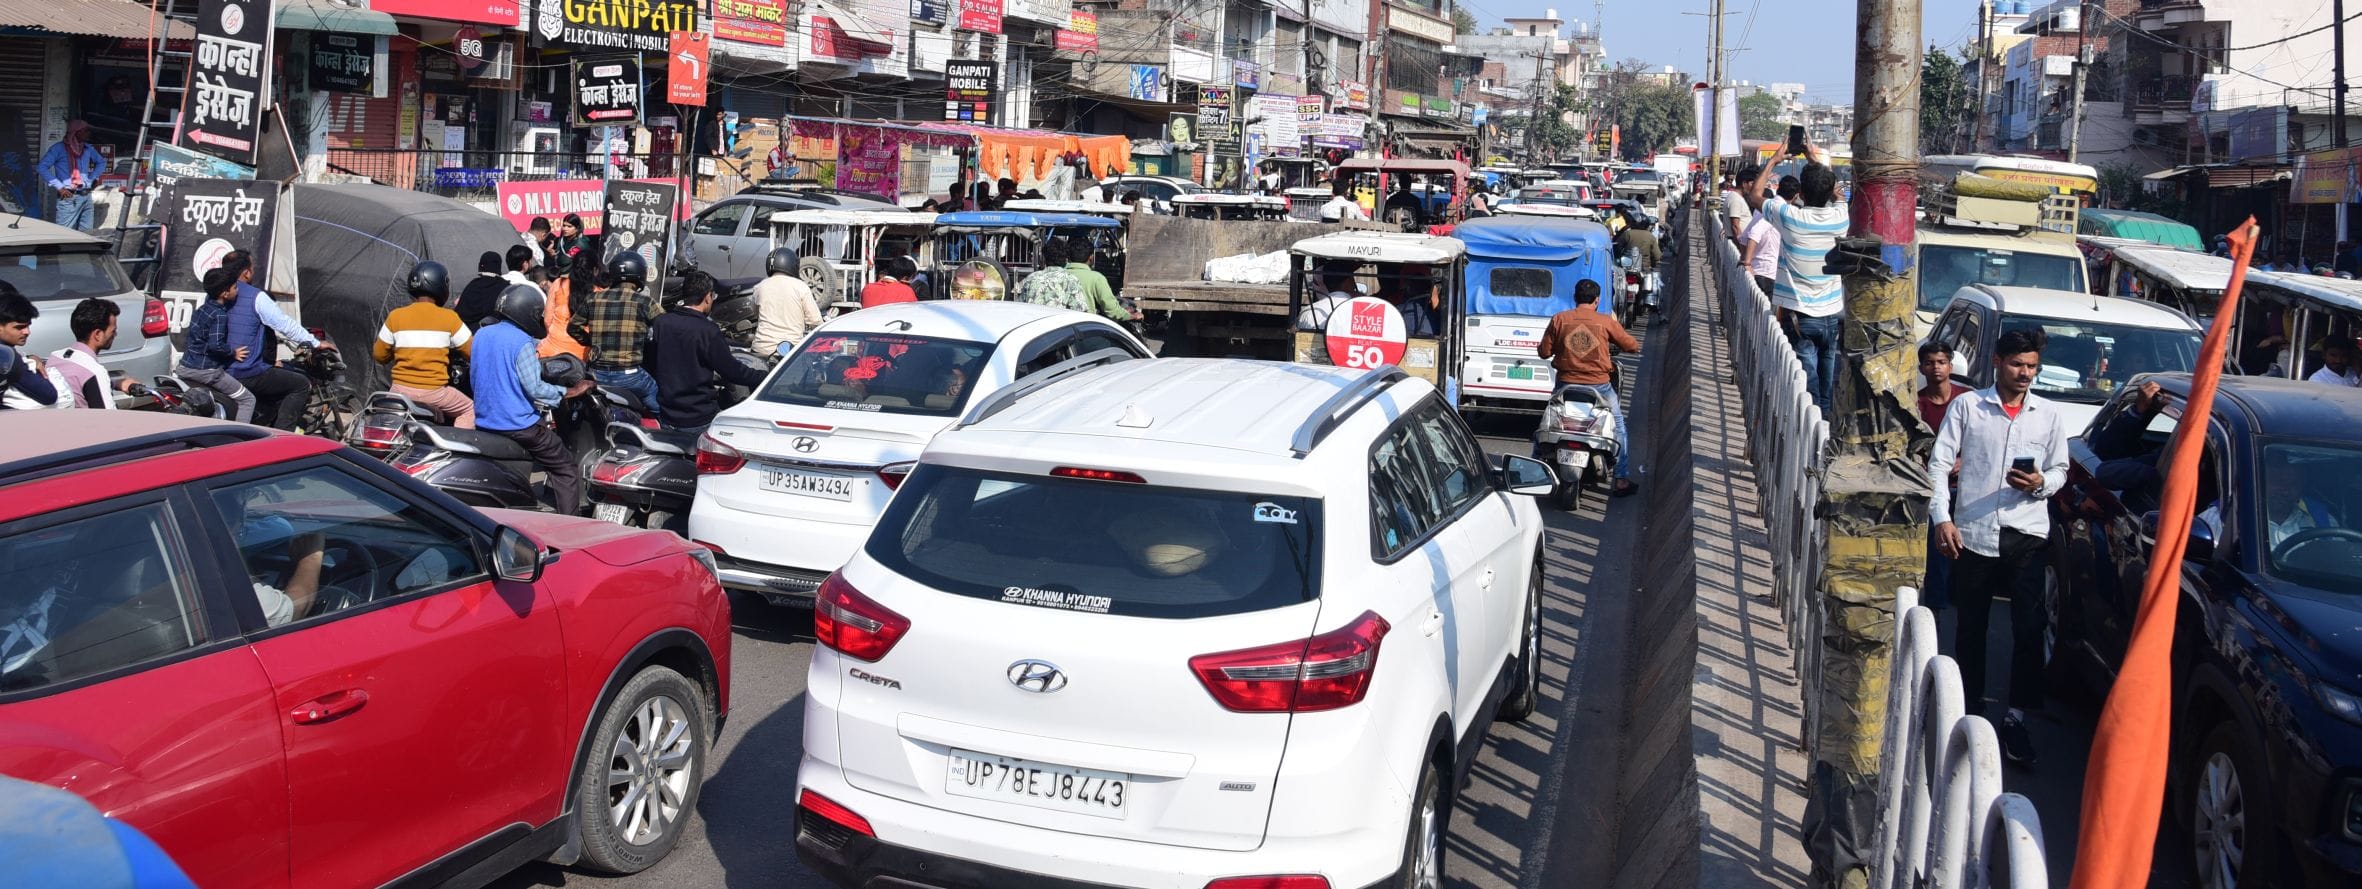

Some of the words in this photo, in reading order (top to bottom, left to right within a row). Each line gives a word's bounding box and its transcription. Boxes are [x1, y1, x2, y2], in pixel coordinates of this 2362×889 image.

[564, 0, 694, 33] GANPATI
[735, 2, 754, 18] राम
[756, 3, 783, 22] मार्केट
[461, 39, 482, 57] 5G
[564, 27, 628, 48] ELECTRONIC
[634, 34, 669, 52] MOBILE
[197, 33, 263, 78] कान्हा
[948, 65, 991, 78] GANPATI
[949, 78, 987, 90] MOBILE
[1201, 90, 1230, 99] YUVA
[1299, 105, 1320, 113] SSC
[525, 192, 557, 214] M.V.
[621, 190, 645, 206] स्कूल
[645, 189, 661, 206] ड्रेस
[183, 195, 233, 234] स्कूल
[231, 189, 264, 232] ड्रेस
[1348, 246, 1382, 256] MAYURI
[1352, 324, 1382, 333] BAAZAR
[1353, 315, 1382, 326] STYLE
[1346, 344, 1384, 369] 50
[768, 470, 850, 496] UP35AW3494
[1023, 588, 1063, 604] KHANNA
[1066, 593, 1111, 609] HYUNDAI
[850, 668, 901, 690] CRETA
[951, 767, 965, 775] IND
[966, 758, 1124, 807] UP78EJ8443
